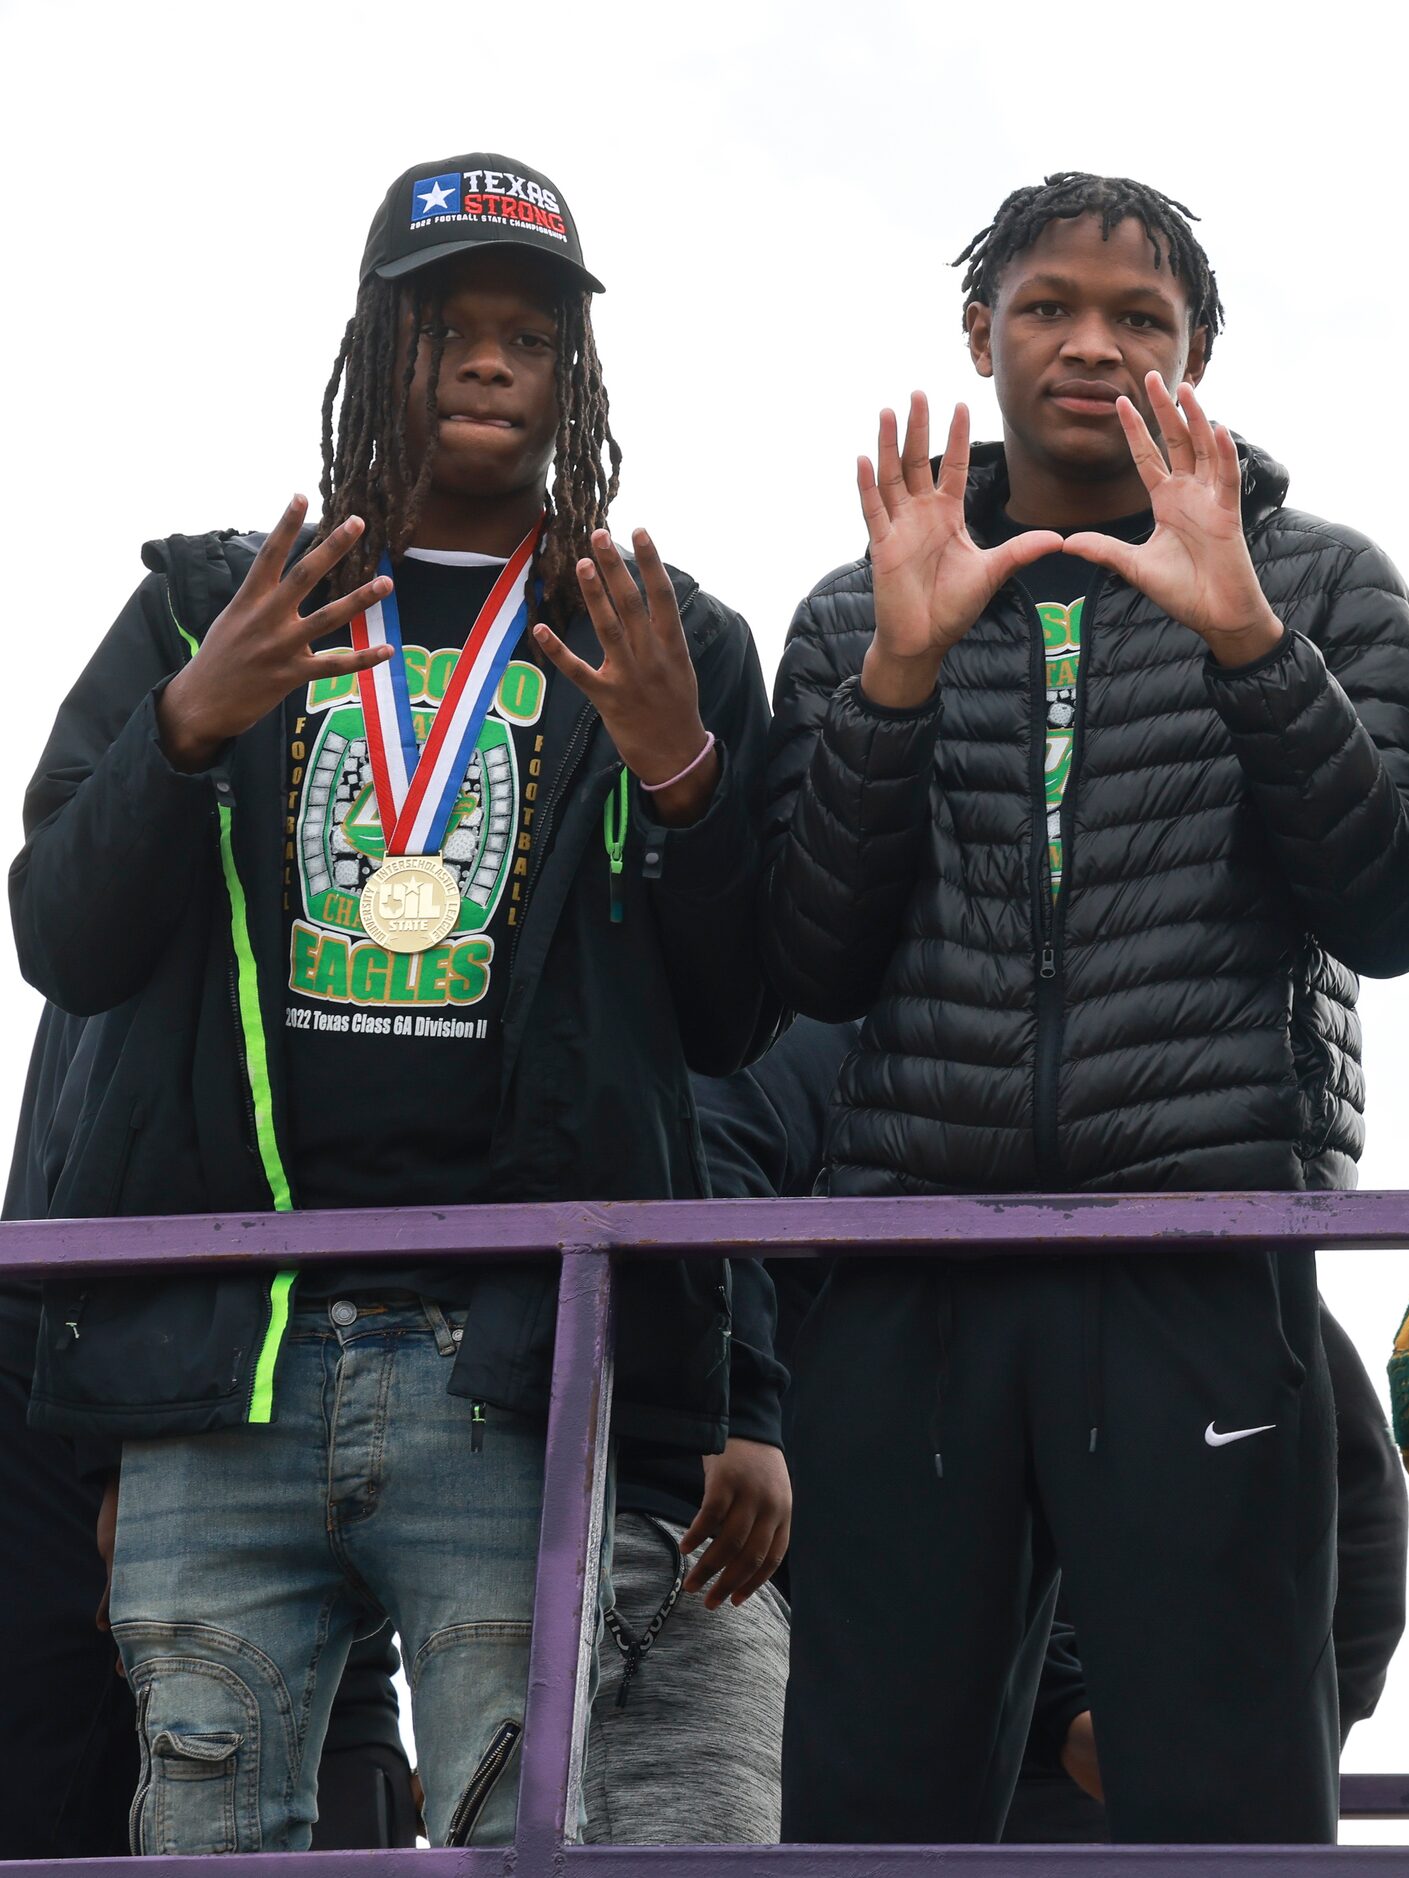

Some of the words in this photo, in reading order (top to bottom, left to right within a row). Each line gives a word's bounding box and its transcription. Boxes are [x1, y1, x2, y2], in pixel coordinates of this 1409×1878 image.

[464, 170, 560, 214] TEXAS
[410, 218, 431, 230] 2022
[434, 214, 478, 224] FOOTBALL
[481, 215, 507, 225] STATE
[509, 218, 568, 243] CHAMPIONSHIPS
[464, 194, 566, 234] STRONG
[507, 734, 544, 927] FOOTBALL
[376, 859, 456, 895] INTERSCHOLASTIC
[388, 920, 429, 931] STATE
[432, 903, 458, 941] LEAGUE
[288, 918, 495, 1007] EAGLES
[285, 1007, 312, 1029] 2022
[312, 1010, 350, 1032] Texas
[351, 1012, 391, 1035] Class
[393, 1015, 412, 1036] 6A
[414, 1016, 474, 1039] Division
[476, 1019, 488, 1039] II
